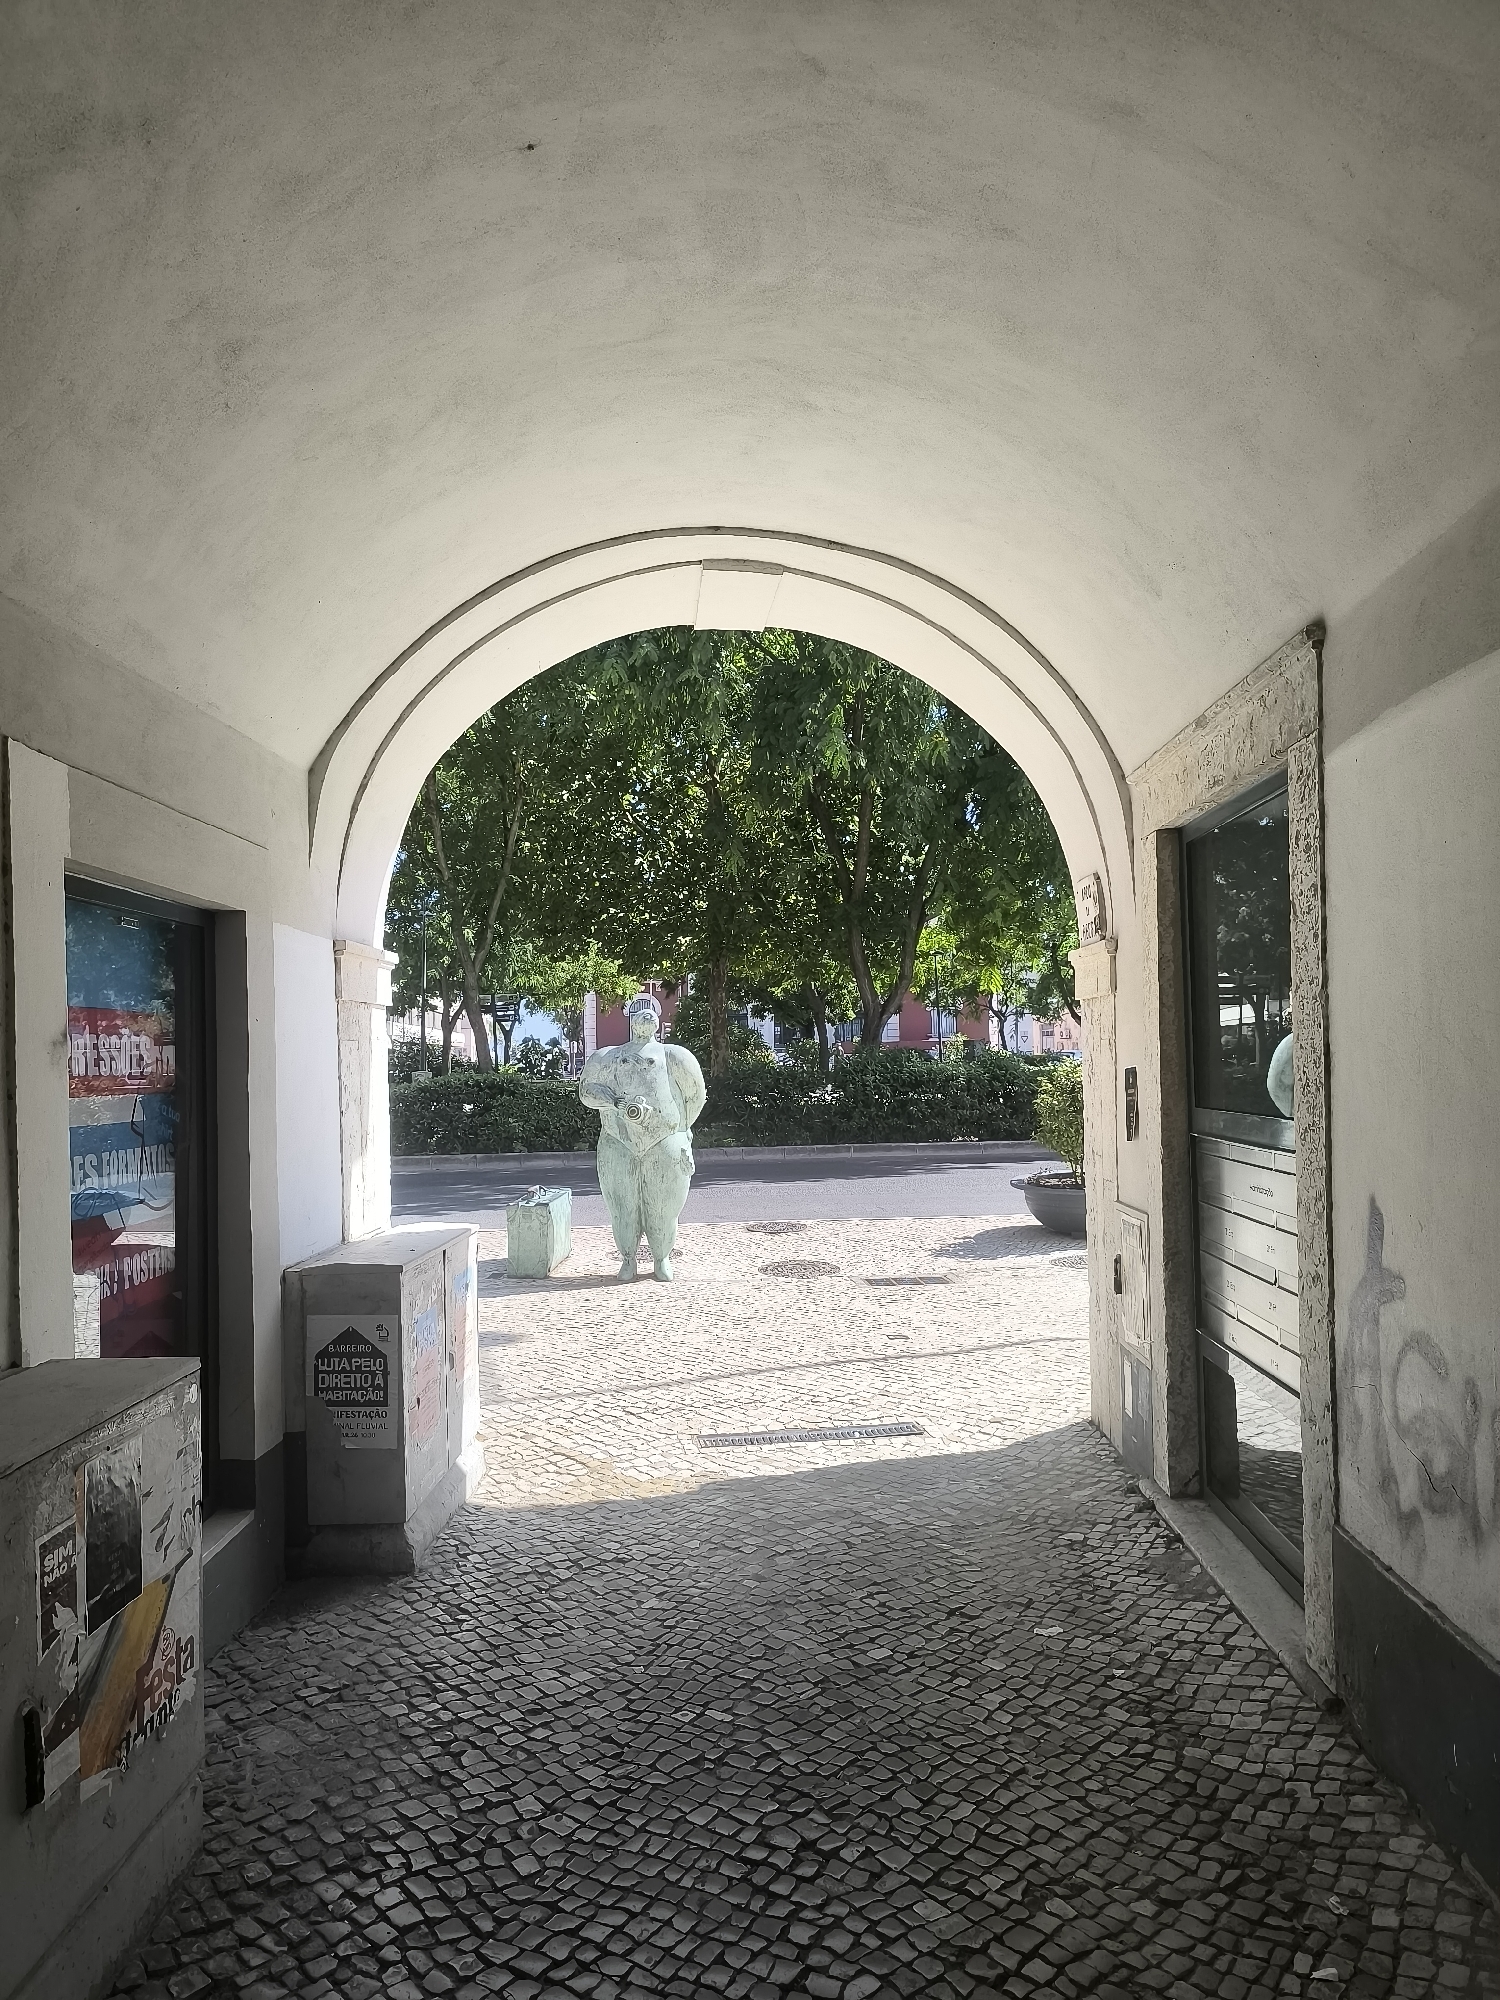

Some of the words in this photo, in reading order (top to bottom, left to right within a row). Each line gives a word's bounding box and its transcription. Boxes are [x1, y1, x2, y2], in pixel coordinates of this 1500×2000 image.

[68, 1028, 152, 1077] RESSÕES
[101, 1142, 176, 1189] FORMATOS
[123, 1247, 176, 1290] POSTERS
[328, 1344, 373, 1353] BARREIRO
[318, 1357, 351, 1371] LUTA
[352, 1357, 384, 1371] PELO
[318, 1373, 372, 1388] DIREITO
[374, 1371, 384, 1388] À
[356, 1422, 389, 1430] FLUVIAL
[136, 1633, 196, 1736] Festa
